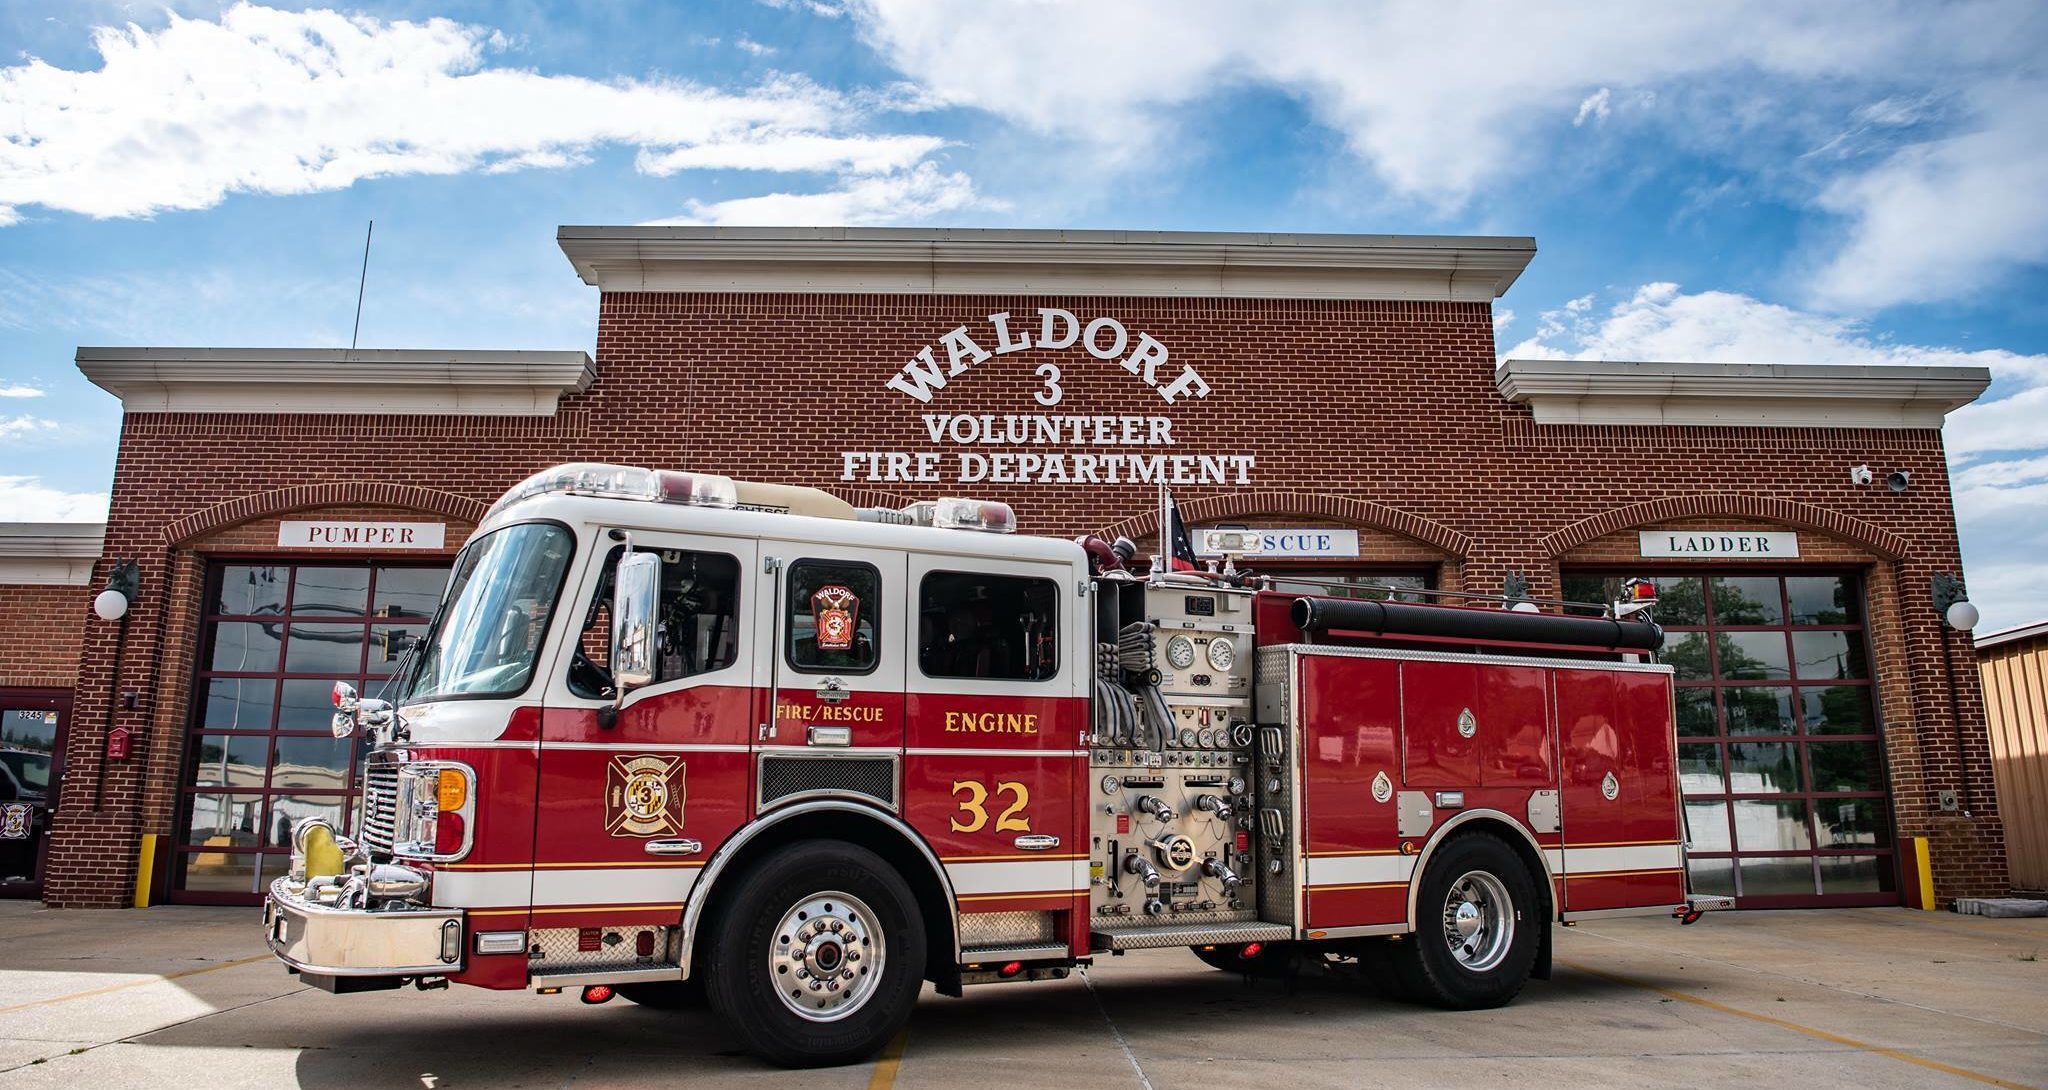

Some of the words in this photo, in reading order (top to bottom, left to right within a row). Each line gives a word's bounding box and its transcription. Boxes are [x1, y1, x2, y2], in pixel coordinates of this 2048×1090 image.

[885, 307, 1212, 405] WALDORF
[1033, 363, 1062, 406] 3
[921, 414, 1176, 445] VOLUNTEER
[840, 452, 940, 482] FIRE
[957, 452, 1255, 485] DEPARTMENT
[308, 526, 415, 544] PUMPER
[1262, 535, 1331, 551] SCUE
[1669, 537, 1771, 552] LADDER
[815, 588, 854, 601] WALDORF
[19, 711, 42, 720] 3245
[776, 704, 884, 722] FIRE/RESCUE
[944, 711, 1038, 734] ENGINE
[640, 786, 652, 804] 3
[950, 780, 1031, 833] 32
